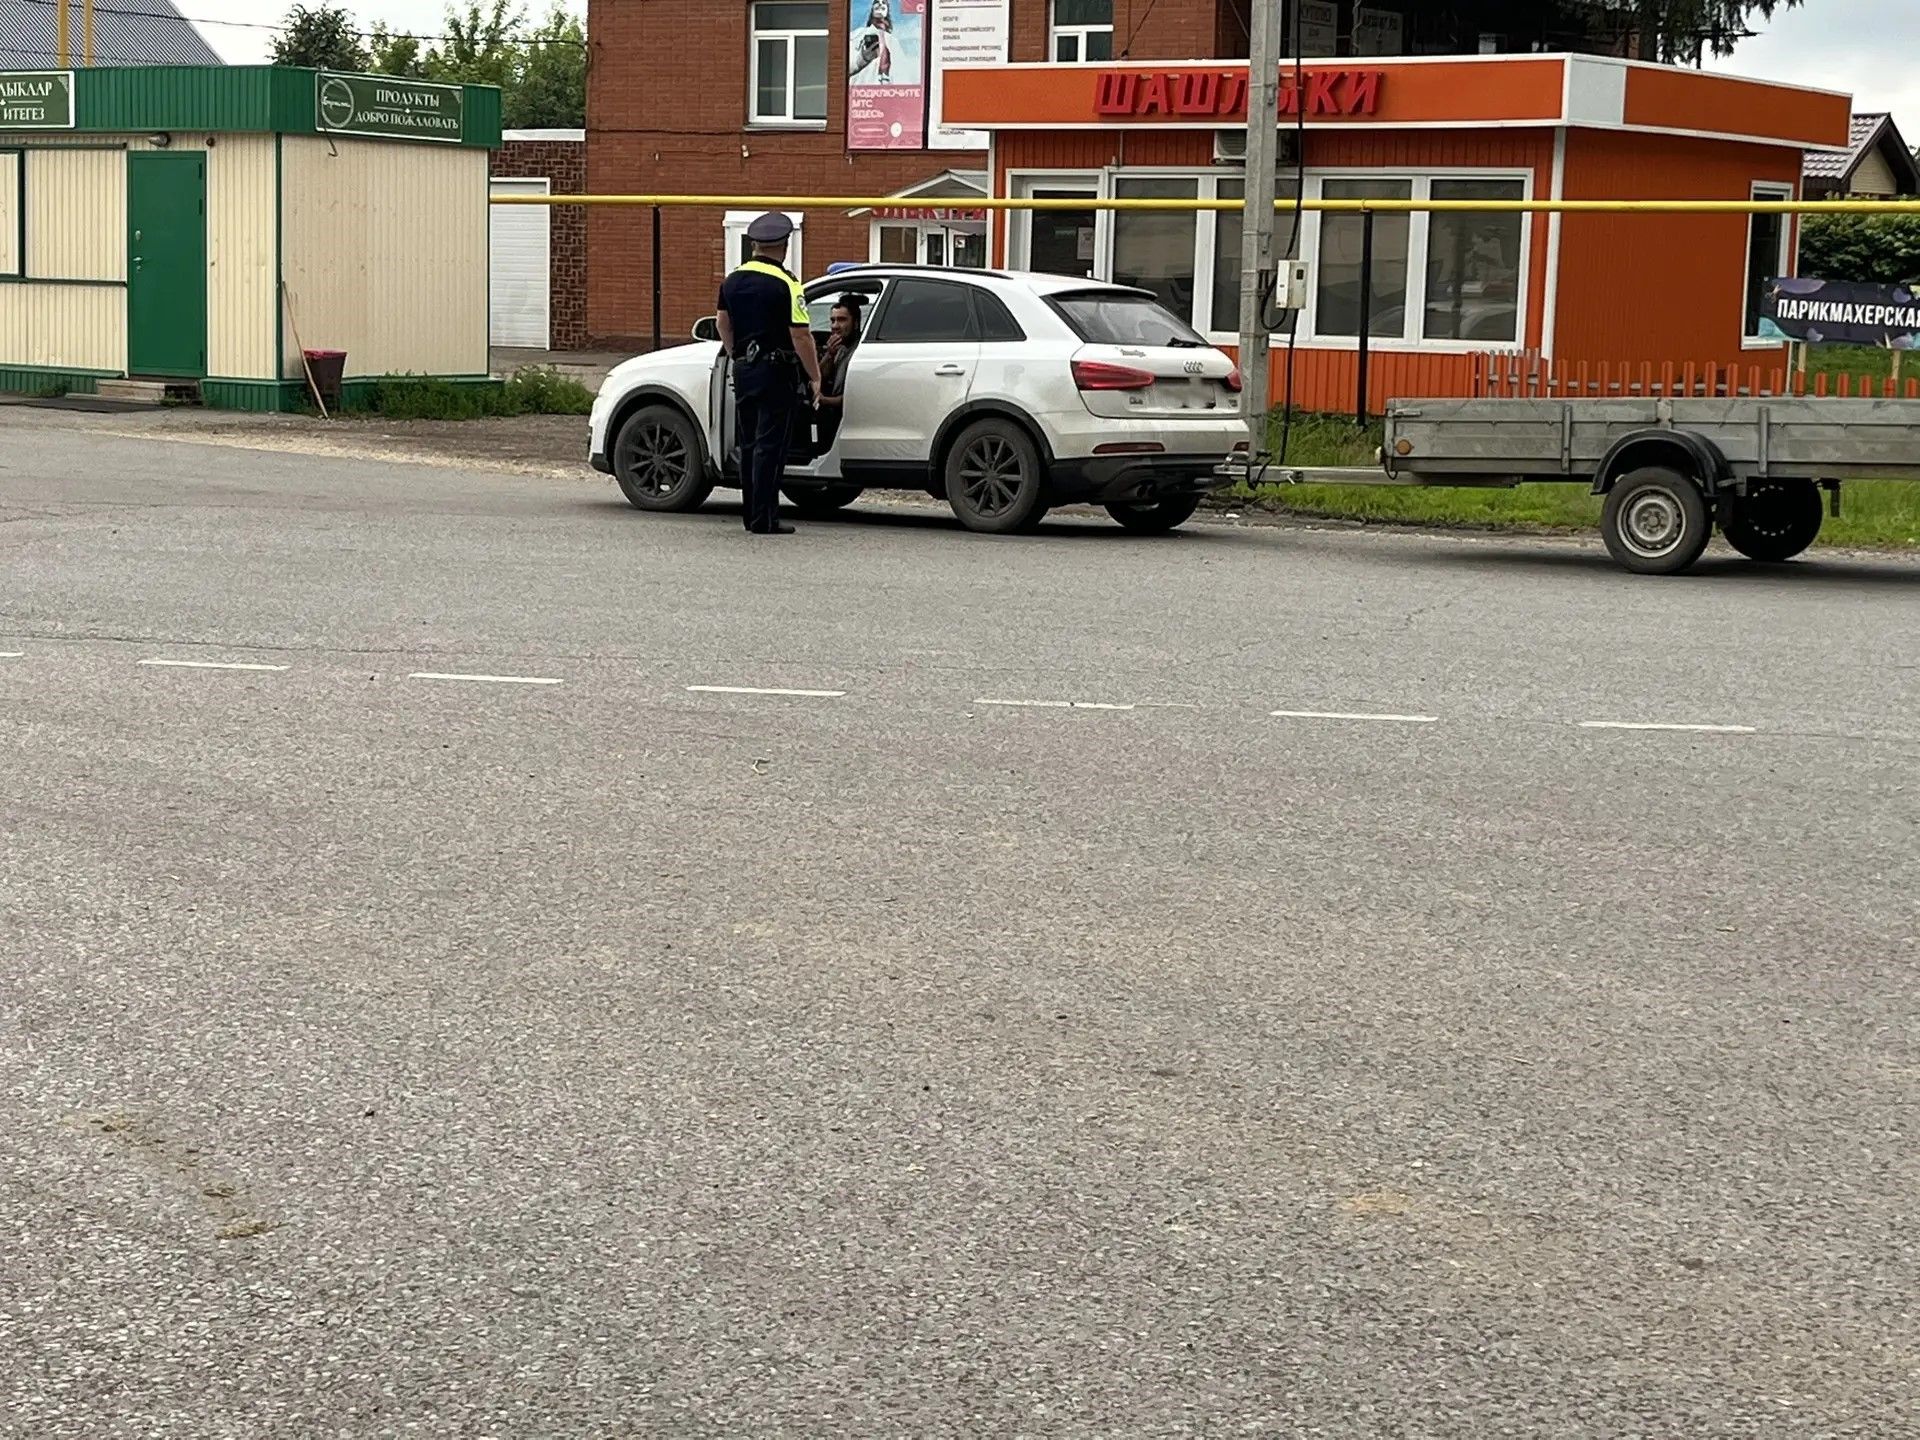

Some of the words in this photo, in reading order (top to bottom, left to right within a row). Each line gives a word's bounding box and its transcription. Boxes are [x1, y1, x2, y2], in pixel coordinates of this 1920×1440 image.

[376, 89, 440, 107] ПРОДУКТЫ
[851, 88, 921, 98] ПОДКЛЮЧИТЕ
[851, 99, 873, 108] МТС
[3, 107, 45, 120] ИТЕГЕЗ
[851, 109, 885, 119] ЗДЕСЬ
[355, 111, 389, 124] ДОБРО
[390, 113, 459, 129] ПОЖАЛОВАТЬ
